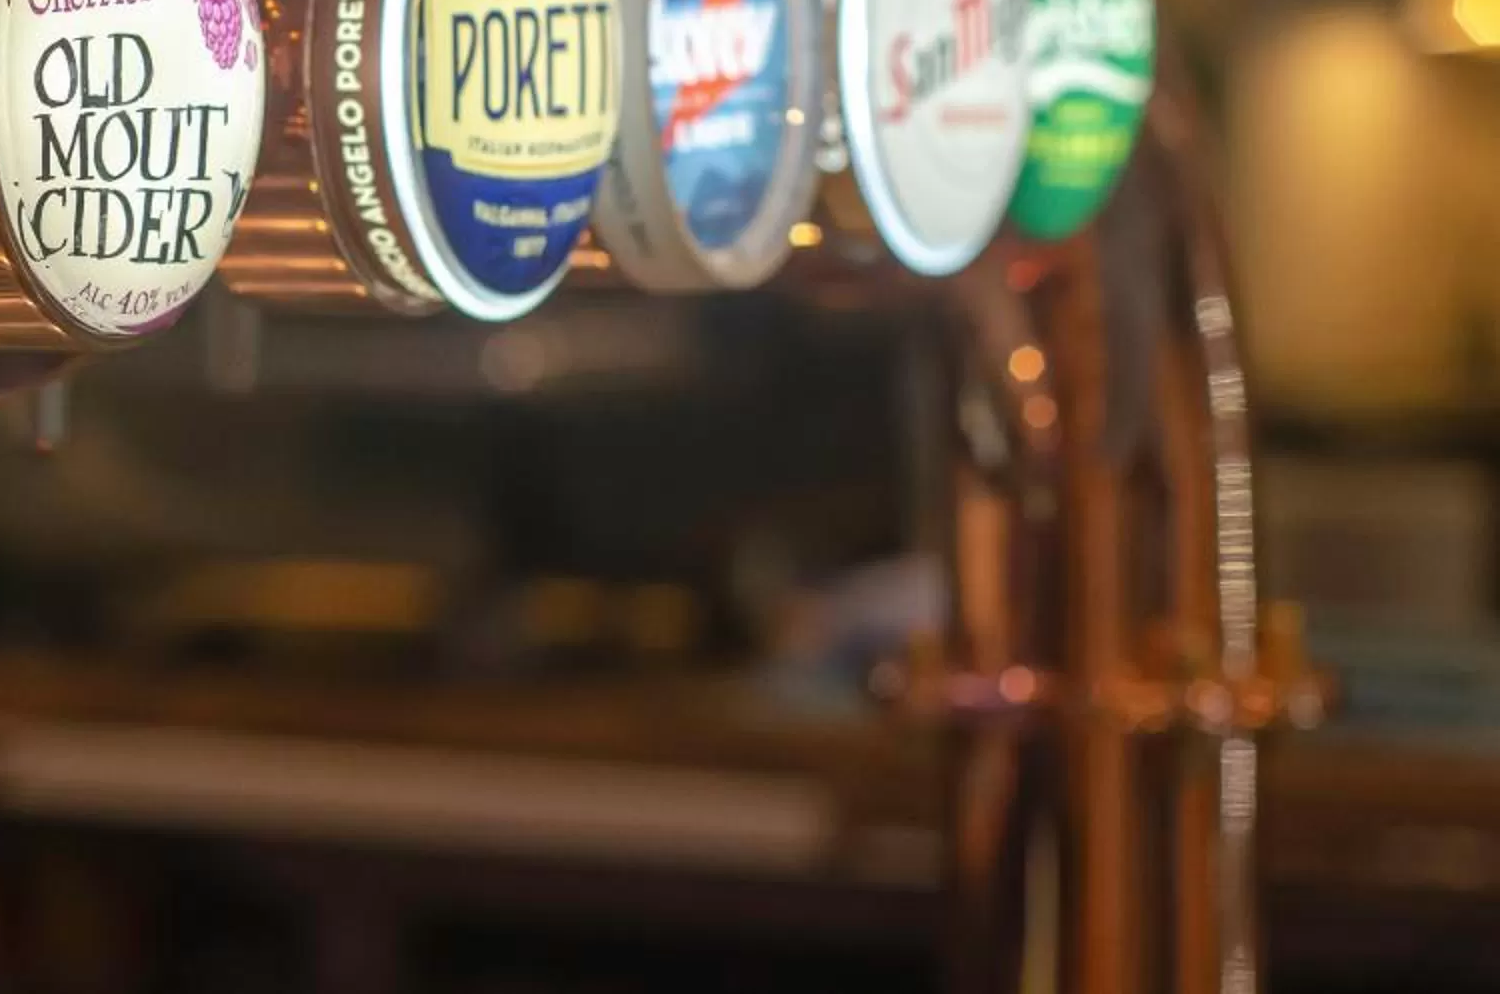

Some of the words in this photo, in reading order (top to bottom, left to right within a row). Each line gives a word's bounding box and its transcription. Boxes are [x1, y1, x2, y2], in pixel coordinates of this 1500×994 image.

[33, 32, 154, 110] OLD
[451, 1, 609, 124] PORETT
[33, 104, 228, 183] MOUT
[337, 98, 389, 226] ANGELO
[30, 186, 213, 265] CIDER
